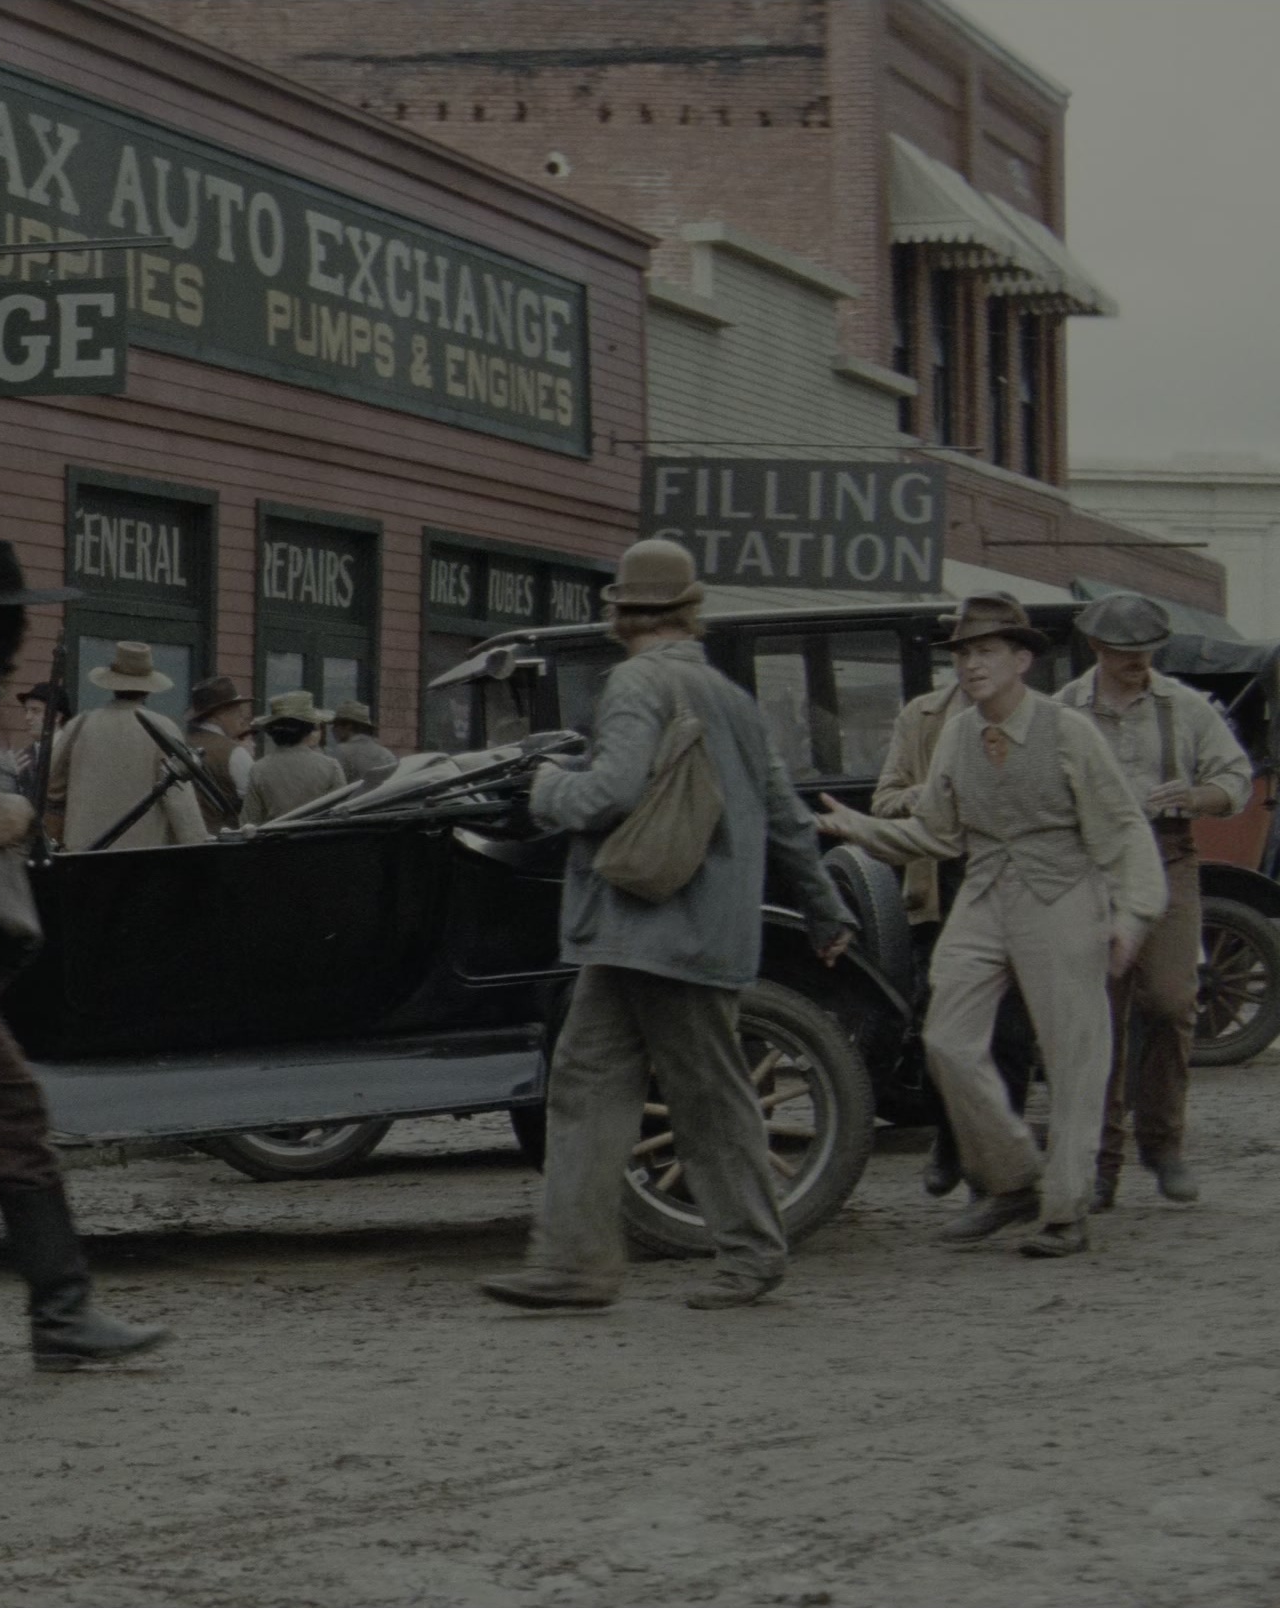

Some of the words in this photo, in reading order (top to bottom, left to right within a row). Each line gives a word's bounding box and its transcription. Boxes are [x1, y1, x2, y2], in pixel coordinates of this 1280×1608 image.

[108, 145, 286, 278] AUTO
[305, 208, 572, 368] EXCHANGE
[266, 289, 396, 379] PUMPS
[408, 334, 434, 390] &
[445, 346, 573, 428] ENGINES
[653, 466, 933, 525] FILLING
[653, 527, 932, 583] TATION
